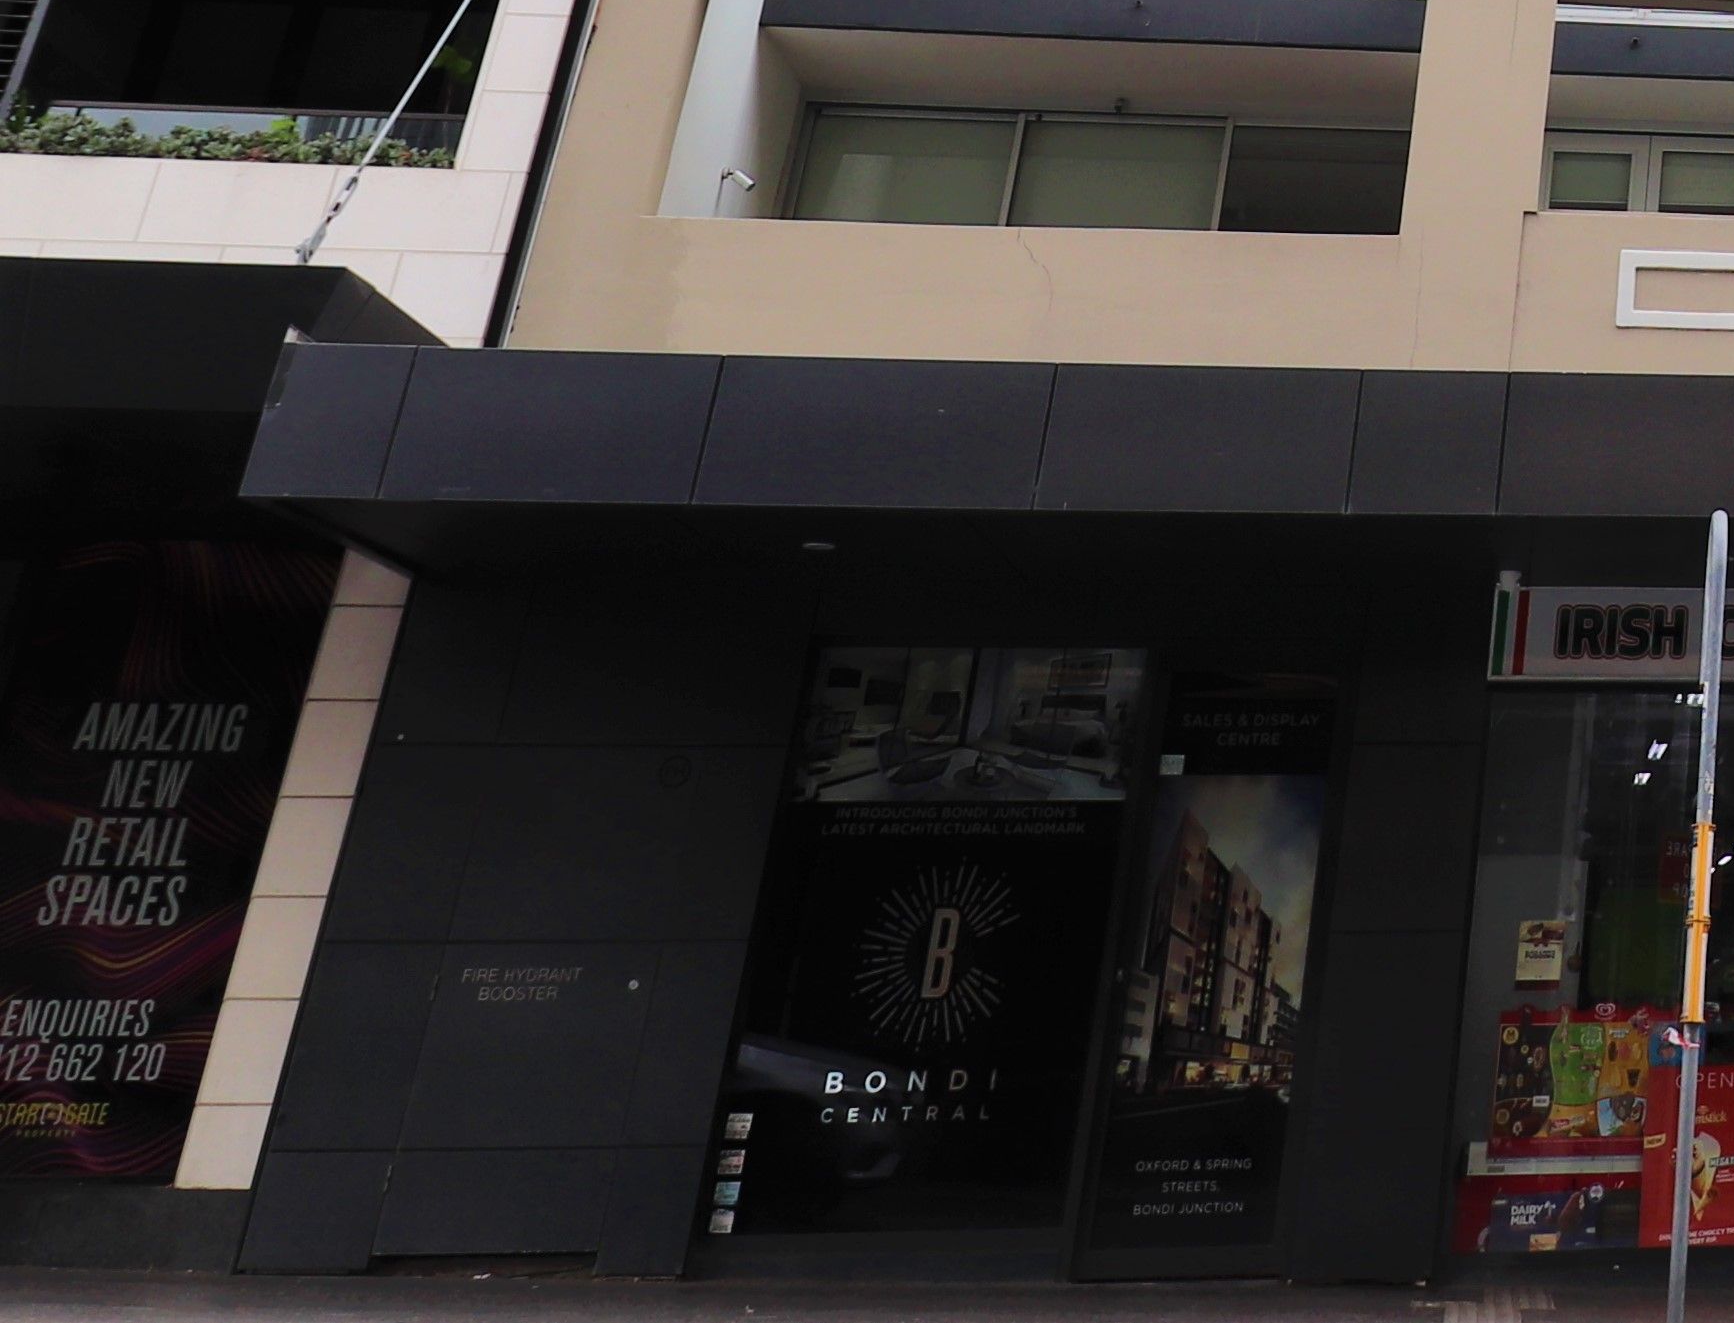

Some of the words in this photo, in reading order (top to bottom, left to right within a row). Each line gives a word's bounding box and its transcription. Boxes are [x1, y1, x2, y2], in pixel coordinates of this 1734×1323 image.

[1554, 604, 1688, 661] IRISH
[72, 701, 249, 753] AMAZING
[1181, 712, 1233, 728] SALES
[1237, 712, 1249, 727] &
[1253, 712, 1321, 727] DISPLAY
[1216, 731, 1281, 747] CENTRE
[99, 758, 194, 809] NEW
[821, 822, 875, 836] LATEST
[879, 822, 1001, 835] ARCHITECTURAL
[1004, 821, 1086, 834] LANDMARK
[61, 816, 189, 868] RETAIL
[36, 874, 188, 927] SPACES
[461, 968, 500, 984] FIRE
[503, 966, 585, 983] HYDRANT
[477, 985, 560, 1002] BOOSTER
[1, 998, 156, 1044] ENQUIRIES
[0, 1042, 40, 1083] 12
[46, 1042, 104, 1083] 662
[112, 1042, 167, 1083] 120
[823, 1068, 998, 1095] BONDI
[820, 1104, 990, 1124] CENTRAL
[1135, 1159, 1190, 1172] OXFORD
[1192, 1158, 1201, 1171] &
[1204, 1157, 1252, 1171] SPRING
[1132, 1202, 1175, 1216] BONDI
[1178, 1201, 1245, 1215] JUNCTION
[1510, 1204, 1543, 1216] DAIRY
[1510, 1215, 1536, 1227] MILK
